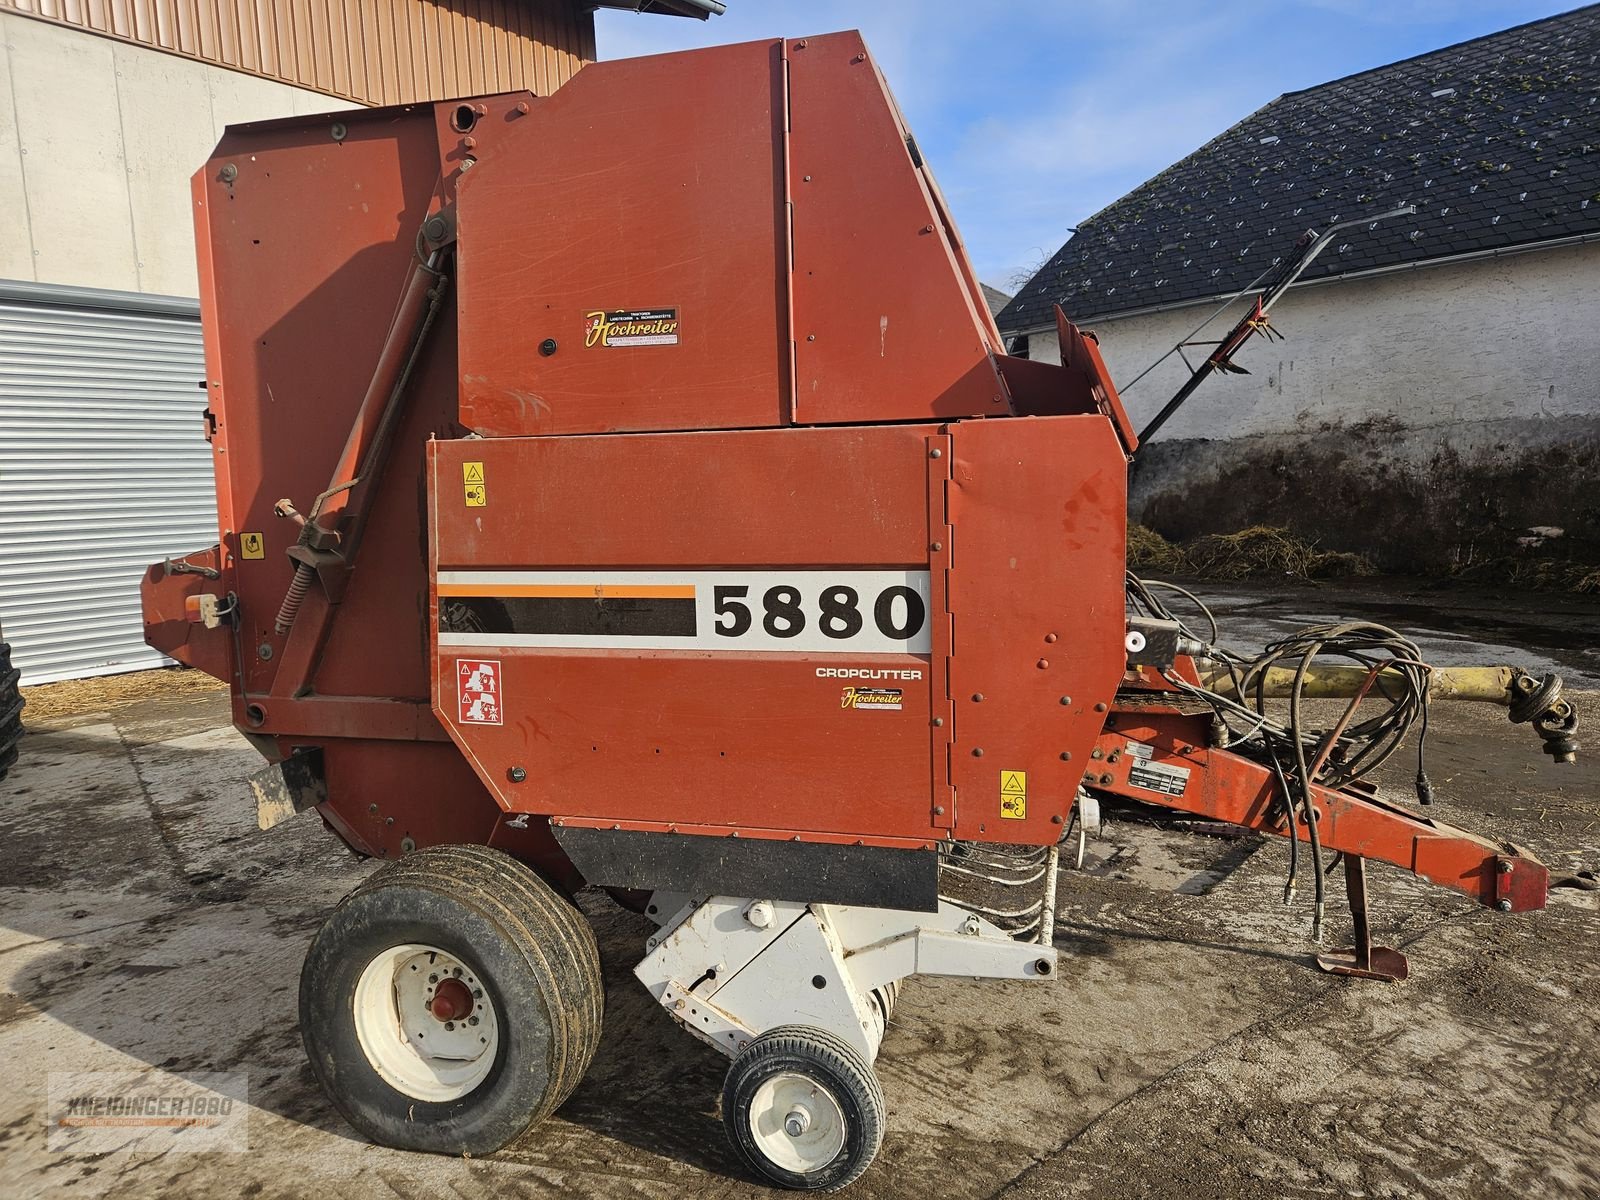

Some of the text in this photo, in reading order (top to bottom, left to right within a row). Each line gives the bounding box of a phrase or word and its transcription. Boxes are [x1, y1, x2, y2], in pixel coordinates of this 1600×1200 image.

[585, 310, 678, 348] Hochreiter
[713, 585, 926, 640] 5880
[815, 667, 922, 680] CROPCUTTER
[841, 686, 902, 709] Hochreiter
